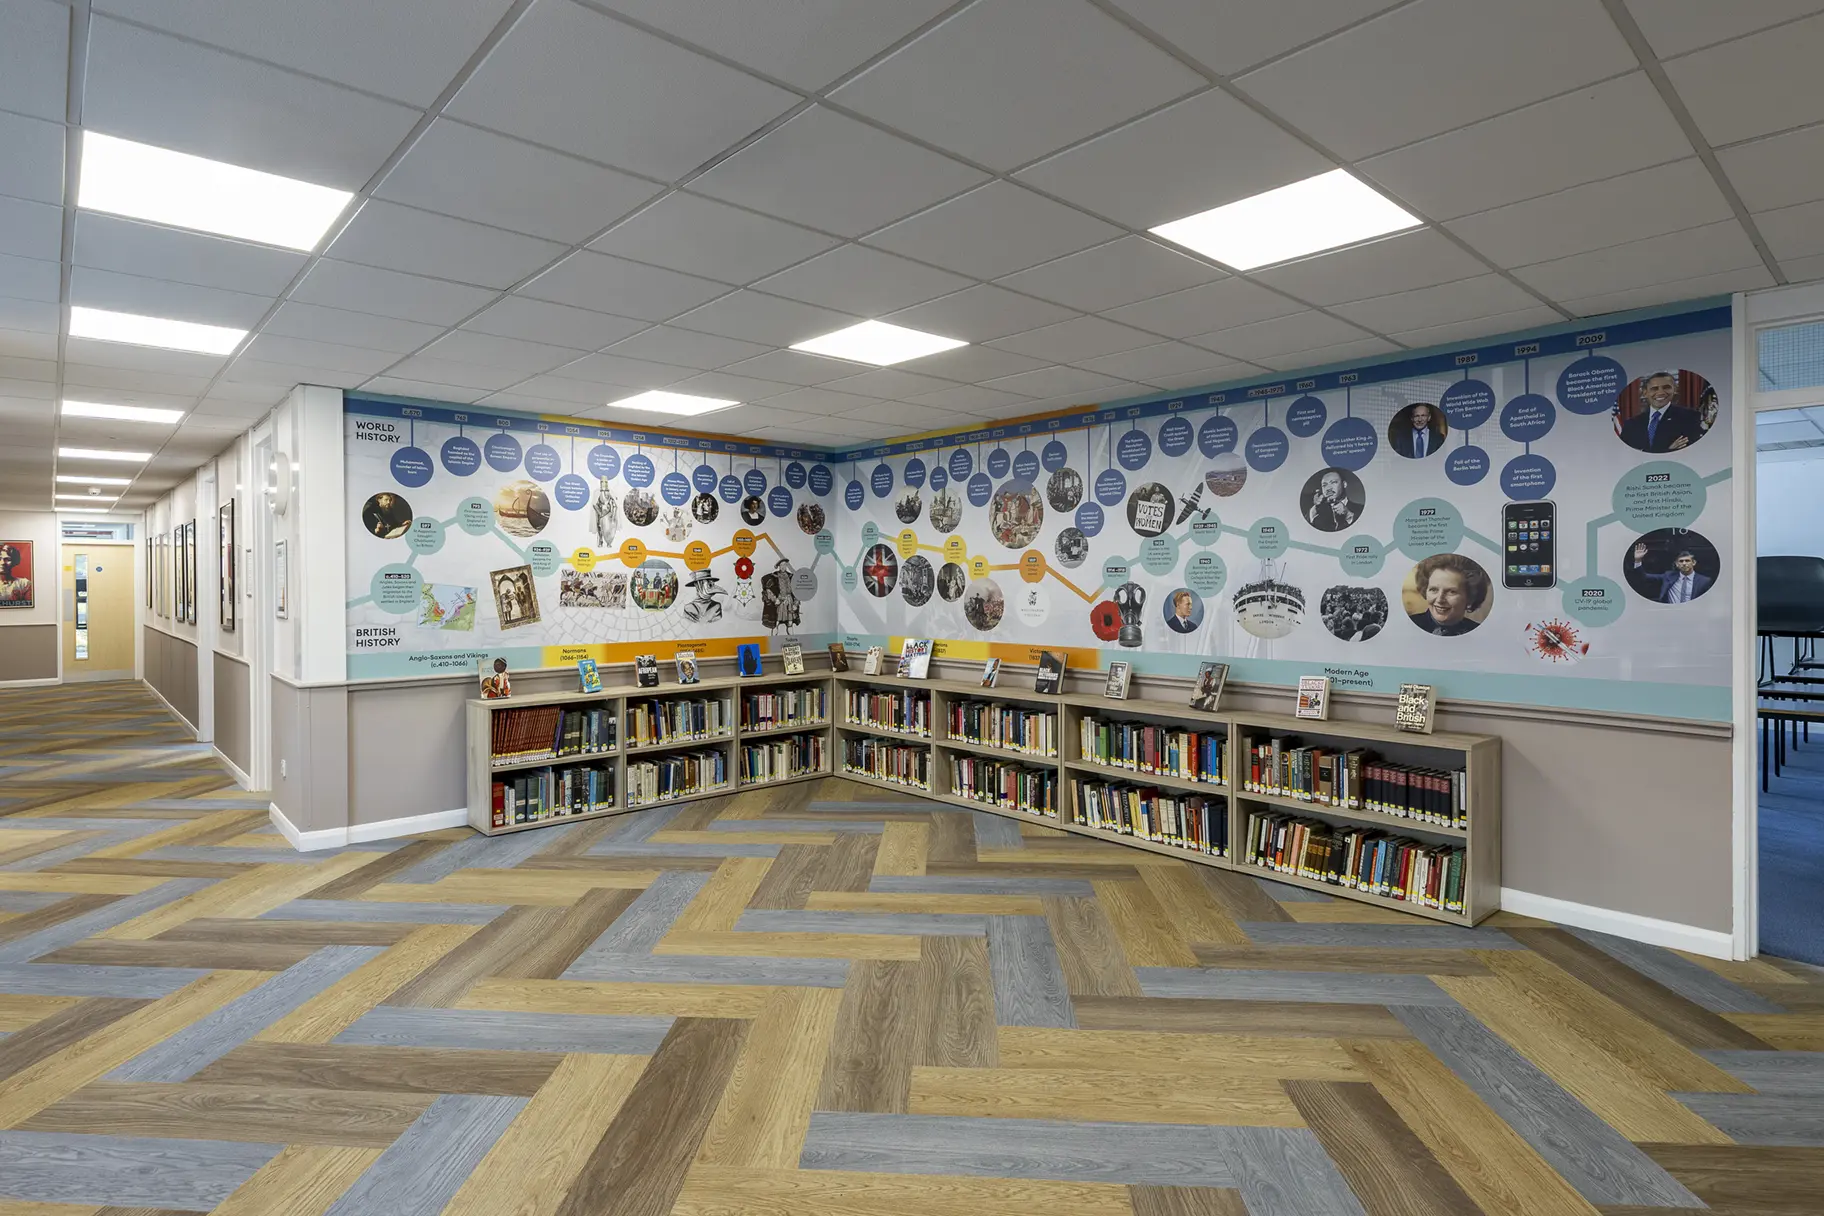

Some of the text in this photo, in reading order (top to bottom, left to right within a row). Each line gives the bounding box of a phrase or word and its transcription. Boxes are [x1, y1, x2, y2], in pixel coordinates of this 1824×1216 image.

[1578, 334, 1603, 344] 2009
[1516, 345, 1537, 354] 1994
[1457, 355, 1475, 364] 1989
[1568, 367, 1614, 378] Barack Obama
[1565, 378, 1591, 386] became
[1585, 381, 1616, 390] American
[1567, 391, 1595, 399] President
[1509, 413, 1538, 422] Apartheid
[355, 421, 395, 432] WORLD
[356, 432, 401, 443] HISTORY
[1648, 474, 1668, 482] 2022
[1138, 504, 1163, 517] VOTES
[1135, 517, 1162, 529] WOMEN
[356, 628, 396, 637] BRITISH
[356, 638, 401, 647] HISTORY
[409, 654, 452, 662] Anglo-Saxons
[1324, 667, 1369, 677] Modern Age
[1399, 694, 1425, 705] Black
[1397, 704, 1415, 713] and
[1396, 712, 1426, 723] British
